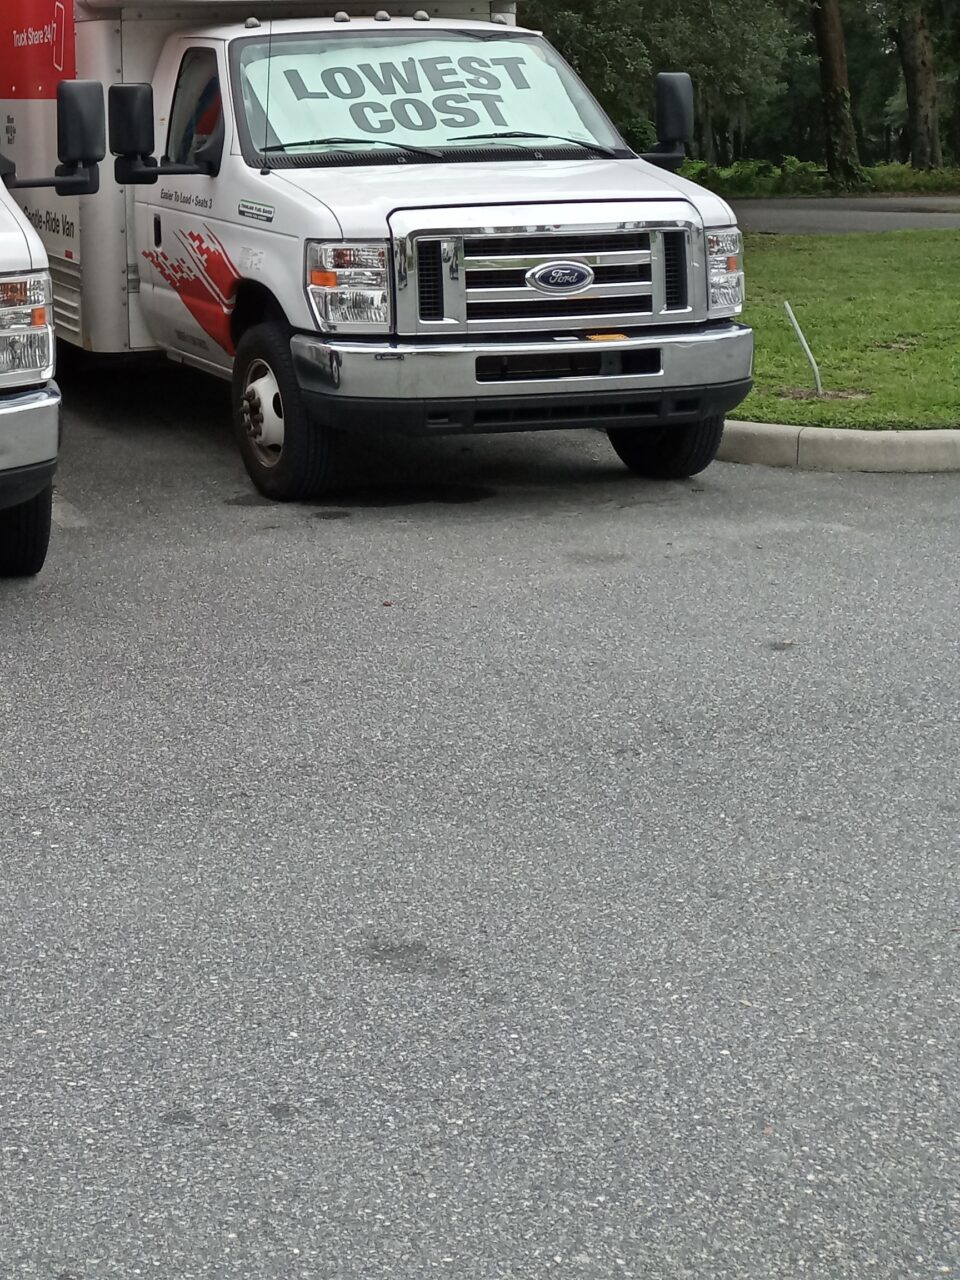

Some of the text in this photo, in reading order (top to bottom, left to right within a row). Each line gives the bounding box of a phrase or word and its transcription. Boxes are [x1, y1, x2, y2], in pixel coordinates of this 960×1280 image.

[12, 20, 57, 48] Truck Share 24/7
[282, 56, 531, 101] LOWEST
[348, 93, 509, 134] COST
[194, 195, 208, 209] Seats
[61, 213, 75, 239] Van
[549, 269, 579, 283] Ford
